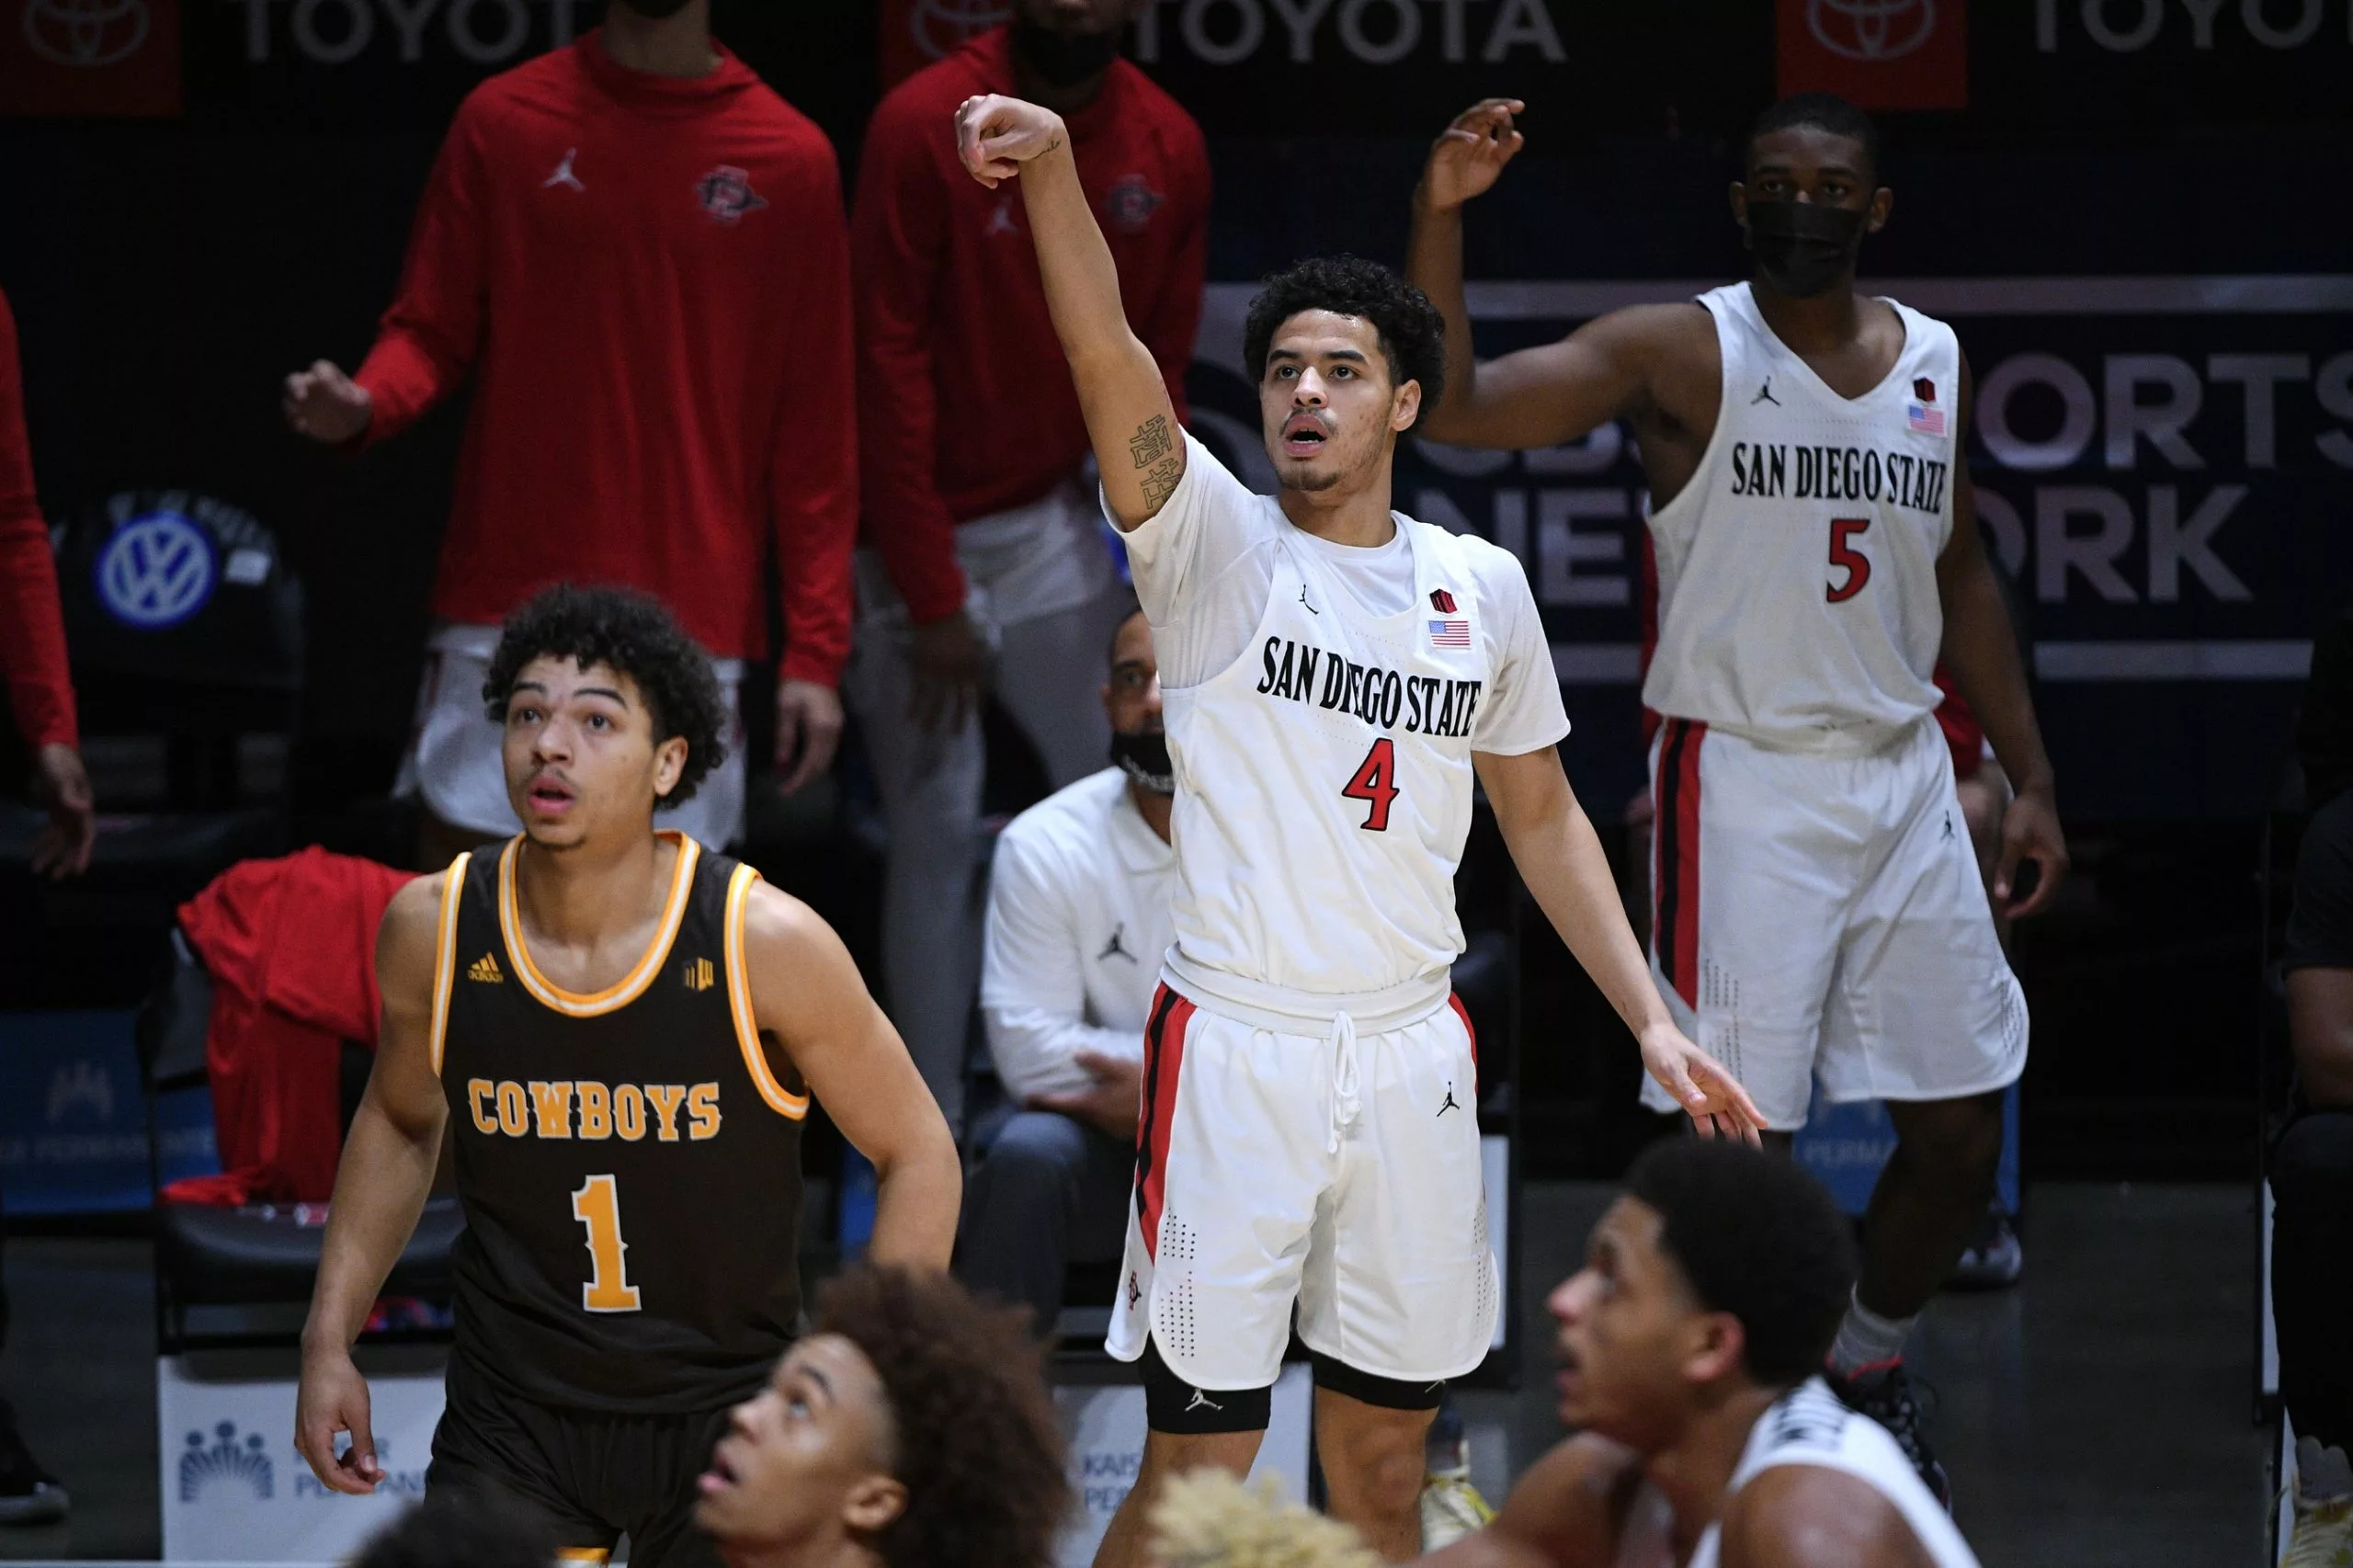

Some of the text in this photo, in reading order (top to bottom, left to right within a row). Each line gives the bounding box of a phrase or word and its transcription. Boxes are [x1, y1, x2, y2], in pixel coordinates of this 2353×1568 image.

[1732, 442, 1947, 515] SAN DIEGO STATE
[1826, 517, 1871, 604] 5
[1256, 635, 1483, 737] SAN DIEGO STATE
[1341, 737, 1401, 832] 4
[467, 1077, 722, 1142] COWBOYS
[570, 1173, 642, 1313] 1
